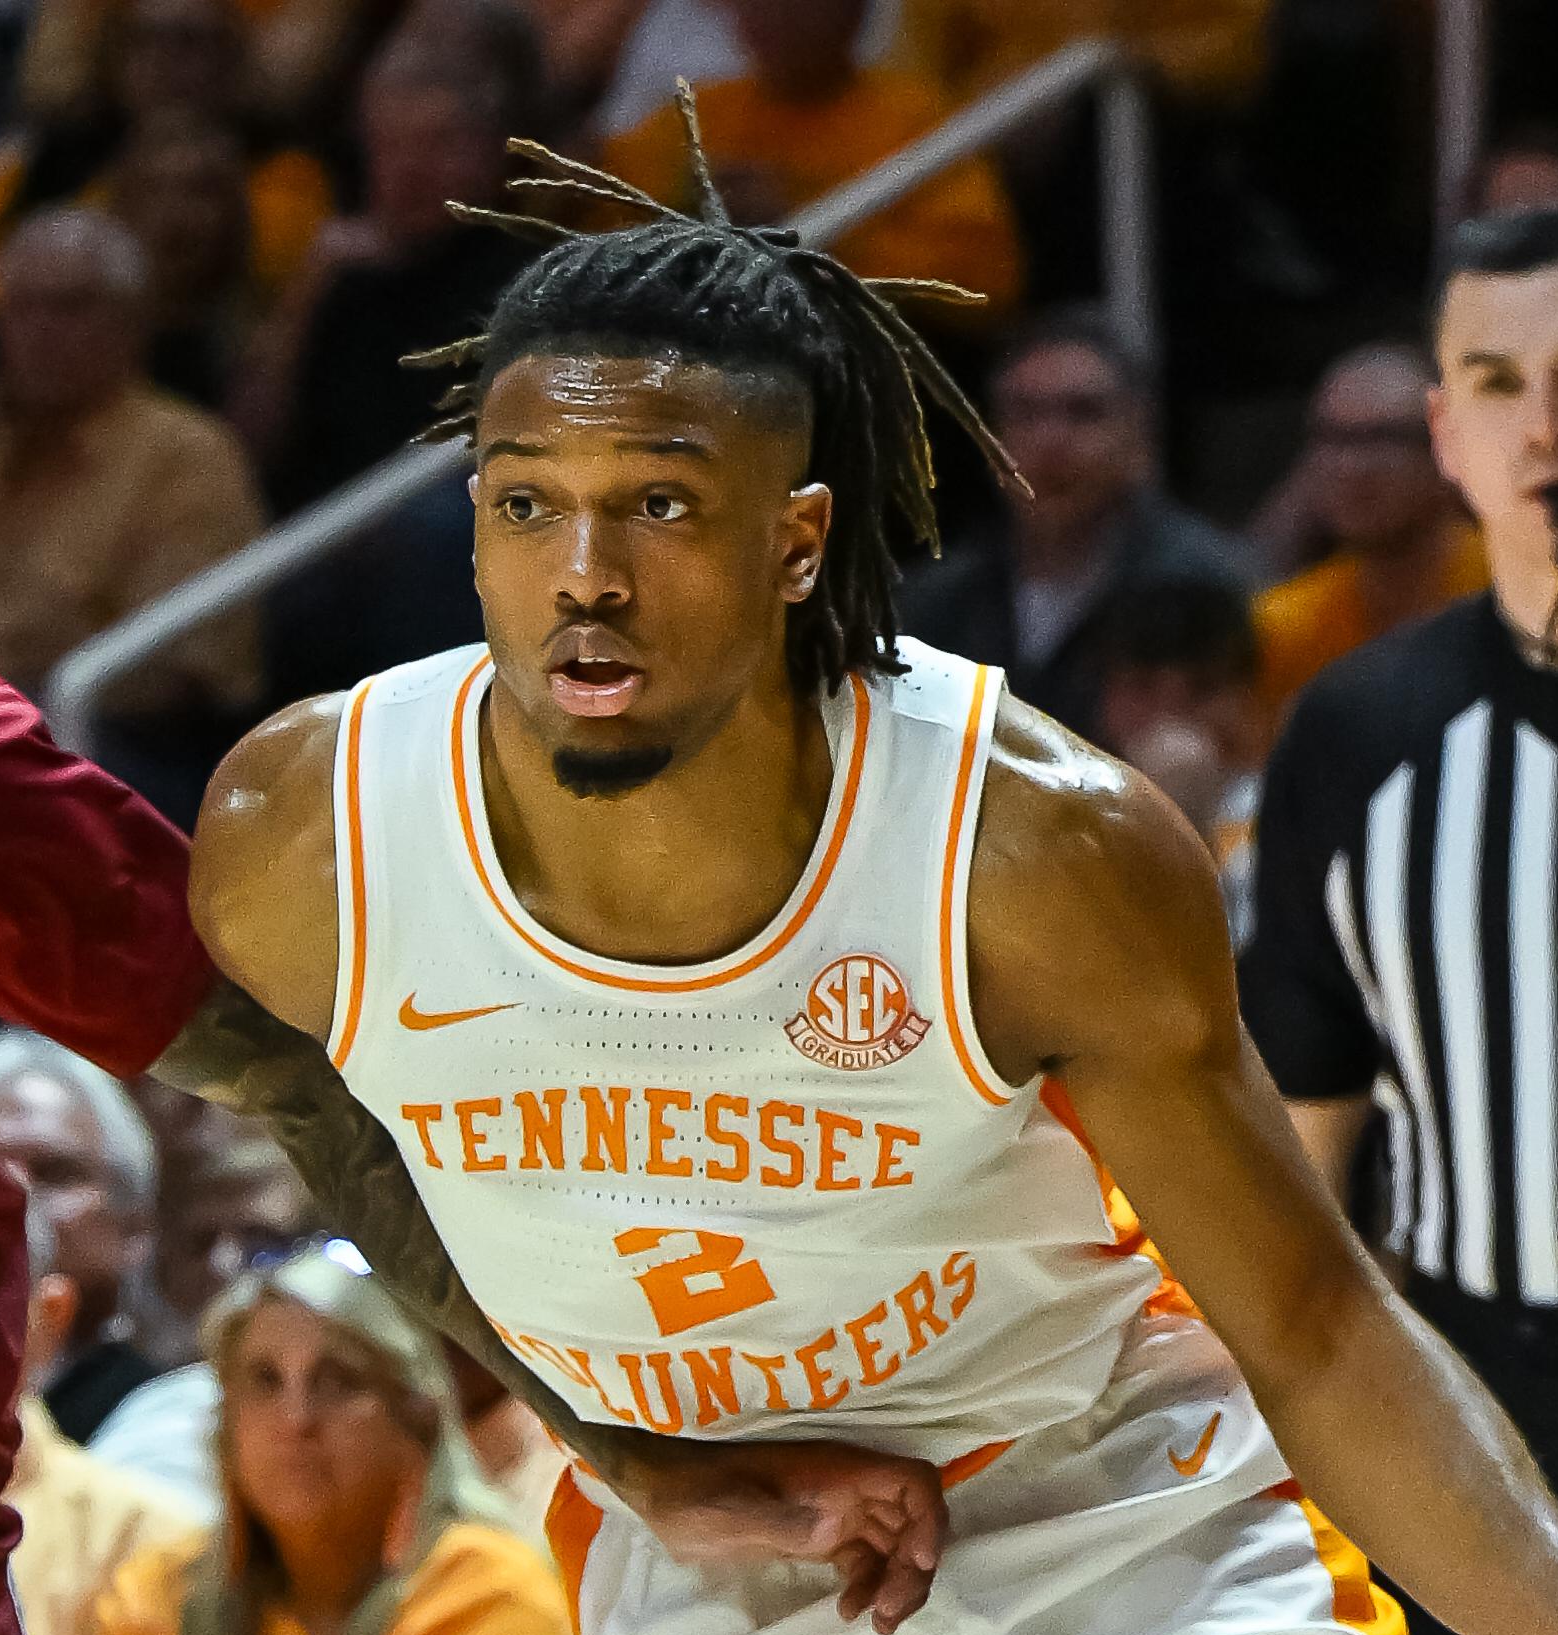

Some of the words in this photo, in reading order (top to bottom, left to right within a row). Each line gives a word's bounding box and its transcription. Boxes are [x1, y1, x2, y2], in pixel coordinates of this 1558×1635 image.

[814, 960, 899, 1042] SEC
[801, 1027, 919, 1069] GRADUATE
[401, 1086, 922, 1191] TENNESSEE
[612, 1226, 777, 1337] 2
